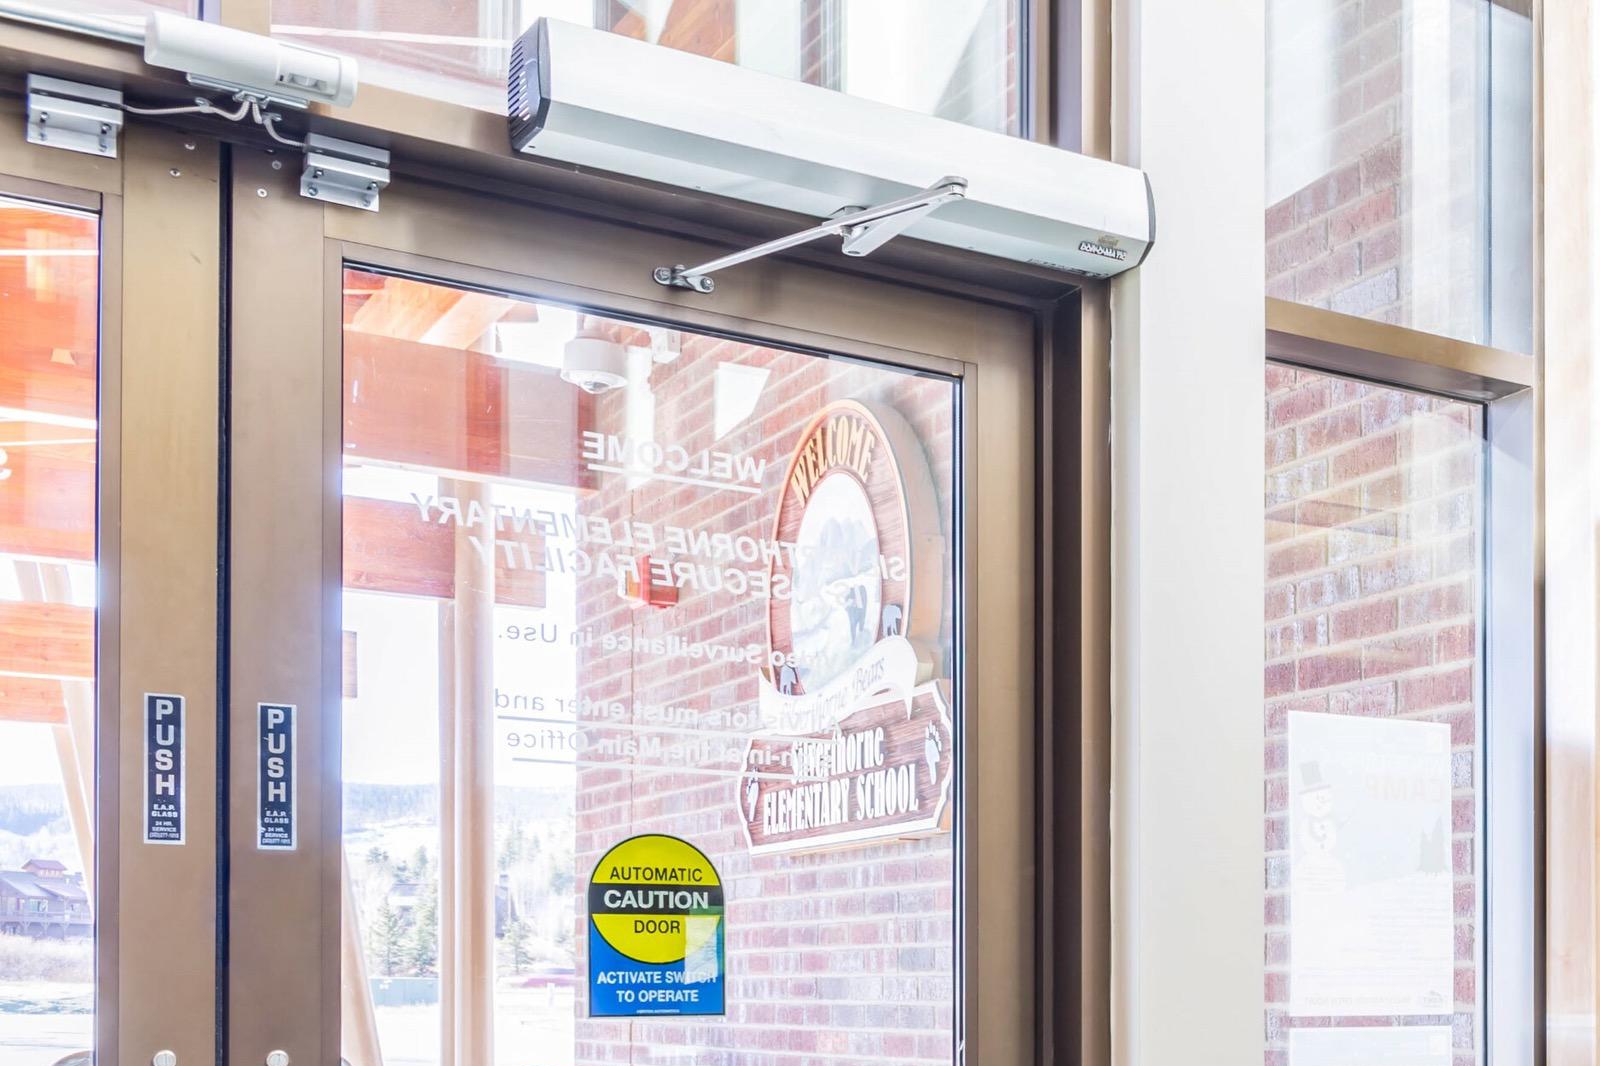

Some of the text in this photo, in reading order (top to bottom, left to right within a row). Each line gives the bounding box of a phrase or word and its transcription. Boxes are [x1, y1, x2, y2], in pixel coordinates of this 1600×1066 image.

[789, 415, 877, 509] WELCOME
[155, 699, 175, 796] PUSH
[267, 708, 287, 803] PUSH
[762, 763, 919, 836] ELEMENTARY SCHOOL
[609, 866, 703, 883] AUTOMATIC
[603, 889, 709, 910] CAUTION
[633, 919, 681, 934] DOOR
[596, 971, 662, 985] ACTIVATE
[615, 989, 700, 1003] TO OPERATE
